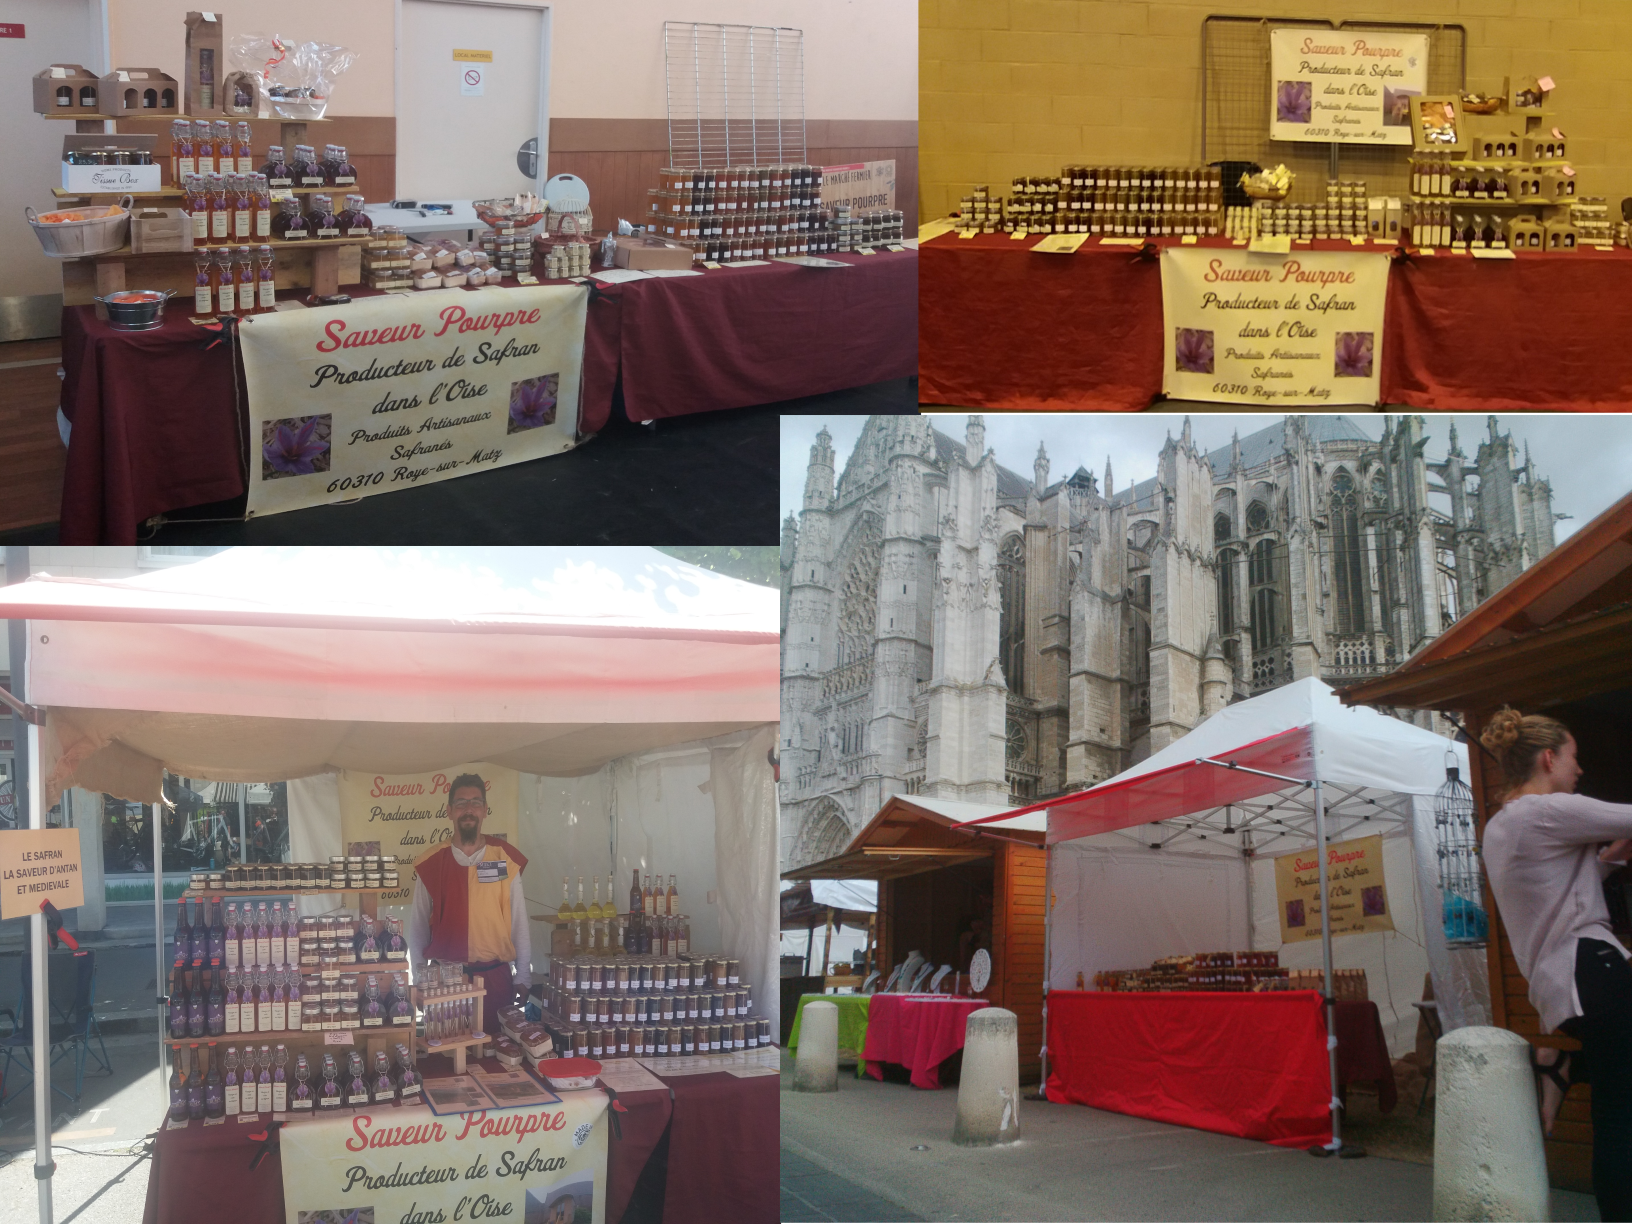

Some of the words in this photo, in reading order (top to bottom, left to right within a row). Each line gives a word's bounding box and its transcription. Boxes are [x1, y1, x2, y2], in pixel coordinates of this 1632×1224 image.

[1300, 37, 1347, 55] Saveur
[1351, 39, 1403, 61] Pourpre
[1298, 61, 1352, 75] Producteur
[1354, 63, 1366, 76] de
[1369, 64, 1404, 79] Safran
[1323, 82, 1346, 95] dans
[1349, 83, 1378, 97] l'Oise
[92, 172, 116, 184] Tissue
[119, 172, 139, 184] Box
[822, 175, 829, 187] LE
[851, 169, 872, 183] FERMIER
[820, 198, 850, 213] SAVEUR
[852, 193, 888, 210] POURPRE
[1204, 258, 1272, 283] Saveur
[1279, 259, 1356, 289] Pourpre
[1200, 291, 1280, 310] Producteur
[1284, 293, 1301, 310] de
[1306, 293, 1357, 315] Safran
[316, 319, 426, 353] Saveur
[433, 305, 541, 337] Pourpre
[1238, 321, 1271, 338] dans
[1276, 320, 1318, 338] l'Oise
[309, 358, 436, 388] Producteur
[441, 346, 465, 369] de
[472, 337, 540, 366] Safran
[1224, 347, 1265, 360] Produits
[371, 391, 422, 415] dans
[428, 379, 488, 405] l'Oise
[1212, 382, 1248, 395] 60310
[348, 425, 413, 446] Produits
[416, 411, 492, 434] Artisanaux
[390, 438, 453, 461] Safranés
[326, 471, 384, 493] 60310
[390, 449, 502, 482] Roye-sur-Matz
[370, 776, 425, 798] Saveur
[368, 805, 432, 822] Producteur
[435, 803, 448, 819] de
[400, 830, 426, 846] dans
[22, 852, 32, 861] LE
[33, 850, 63, 860] SAFRAN
[1328, 850, 1366, 865] Pourpre
[3, 870, 15, 879] LA
[16, 867, 48, 878] SAVEUR
[49, 863, 78, 875] D'ANTAN
[17, 884, 27, 894] ET
[29, 880, 70, 893] MEDIEVALE
[345, 1115, 447, 1152] Saveur
[455, 1110, 566, 1144] Pourpre
[342, 1162, 459, 1193] Producteur
[465, 1153, 488, 1180] de
[495, 1147, 568, 1181] Safran
[399, 1202, 447, 1224] dans
[453, 1194, 513, 1222] l'Oise
